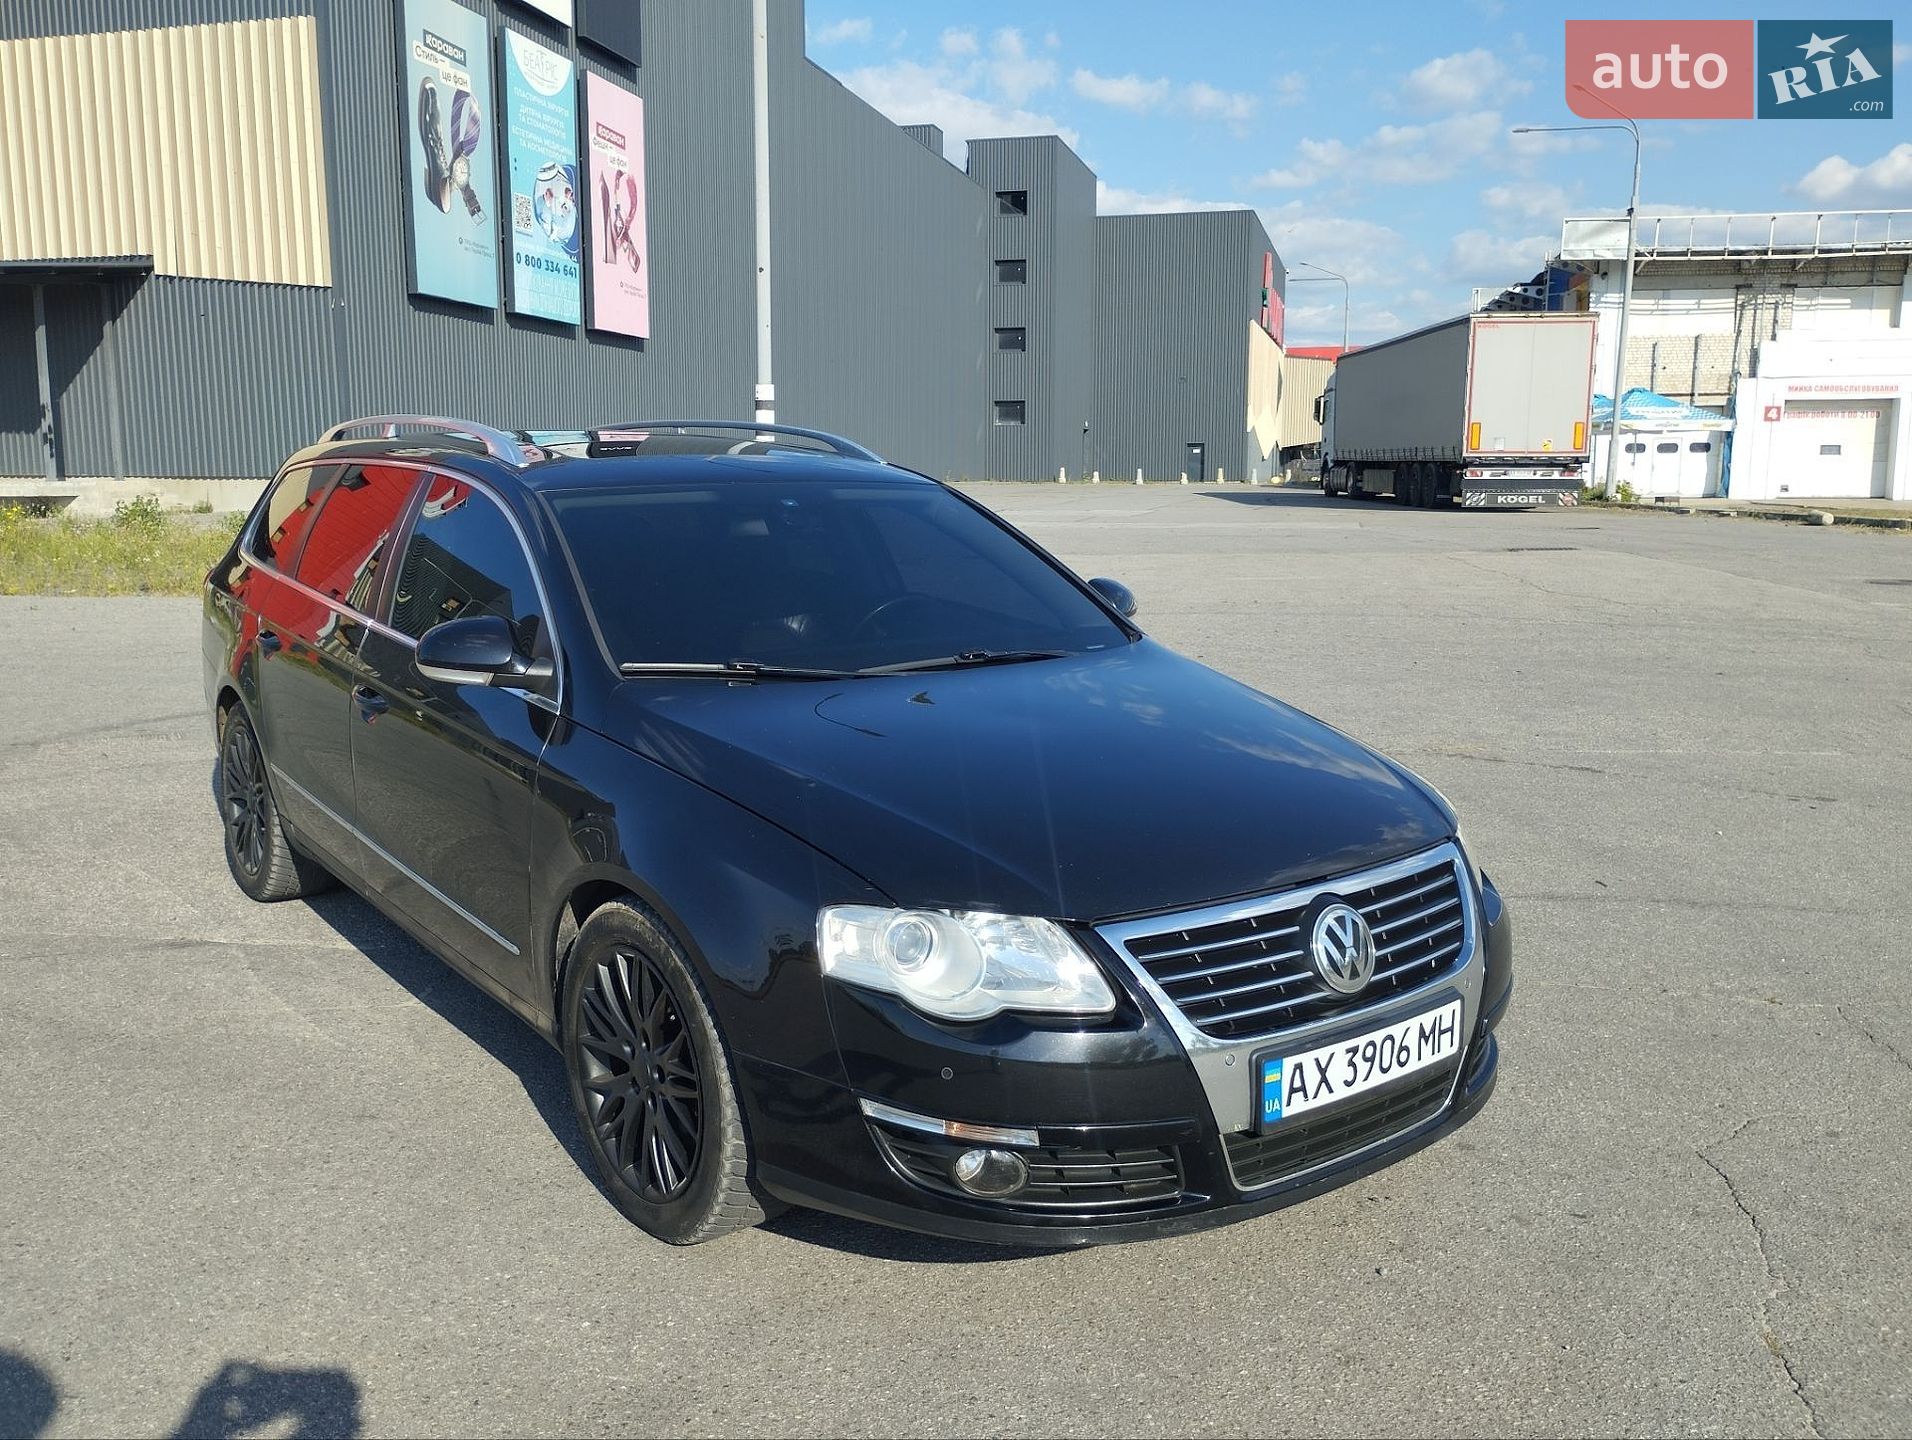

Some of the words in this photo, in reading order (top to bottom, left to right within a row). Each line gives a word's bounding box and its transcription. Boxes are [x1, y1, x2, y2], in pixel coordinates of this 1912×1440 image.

[516, 252, 522, 264] 0
[524, 254, 542, 270] 800
[544, 259, 560, 274] 334
[563, 265, 577, 278] 641
[1767, 407, 1778, 419] 4
[1286, 1052, 1335, 1107] AX
[1343, 1027, 1411, 1088] 3906
[1417, 1009, 1456, 1062] MH
[1265, 1097, 1281, 1113] UA
